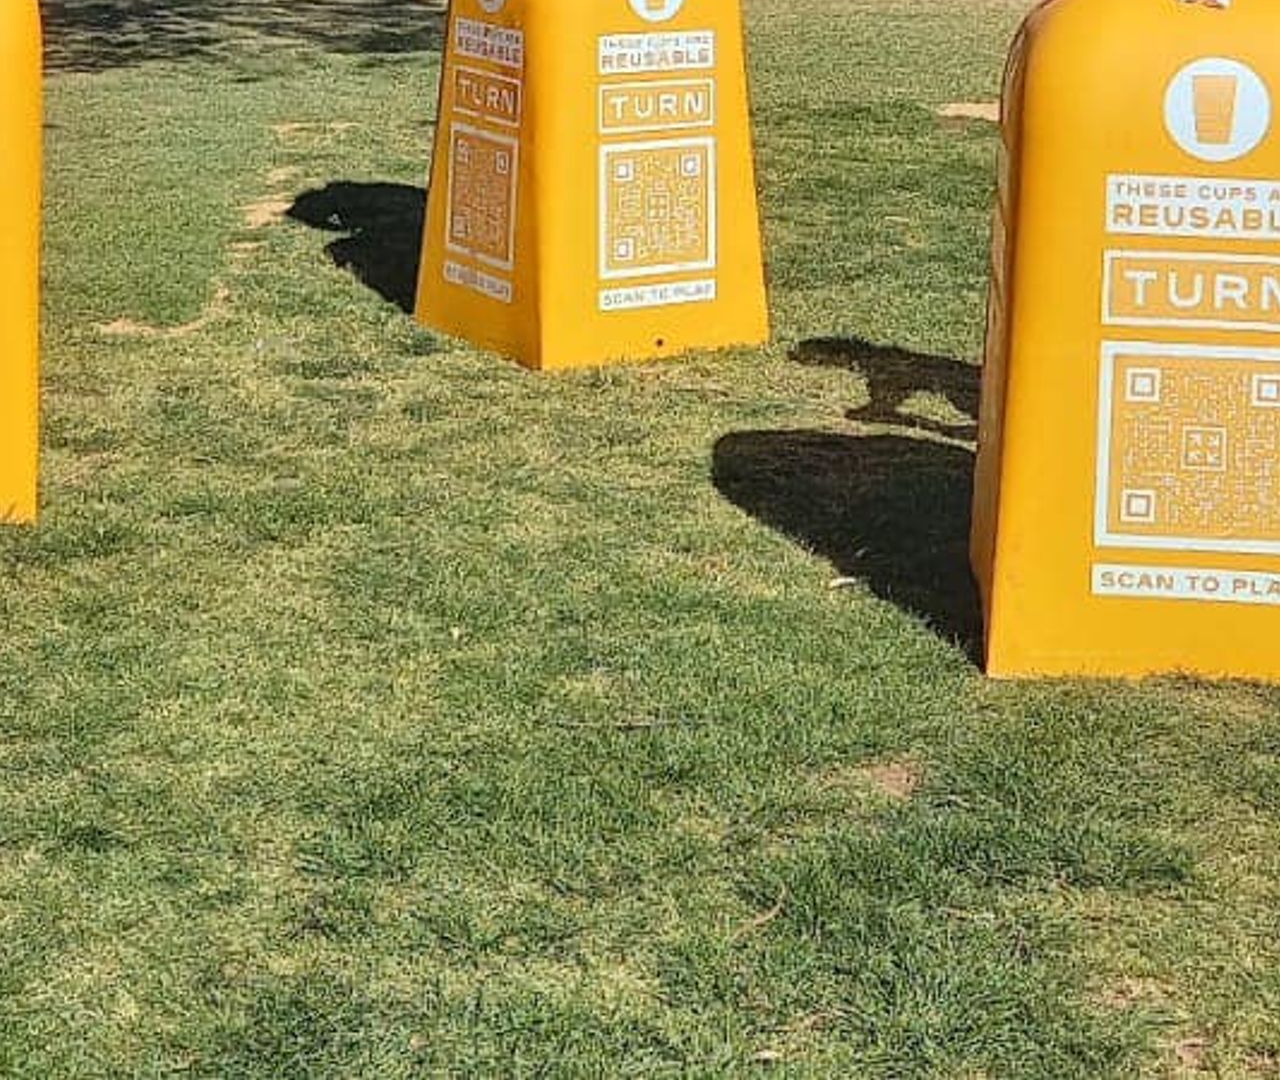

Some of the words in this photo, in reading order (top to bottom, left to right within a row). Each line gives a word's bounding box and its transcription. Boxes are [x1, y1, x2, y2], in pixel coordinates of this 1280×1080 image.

[601, 48, 710, 69] REUSABLE
[458, 78, 515, 115] TURN
[609, 93, 705, 119] TURN
[1113, 182, 1187, 198] THESE
[1197, 184, 1257, 201] CUPS
[1101, 570, 1175, 591] SCAN
[1186, 575, 1220, 593] TO
